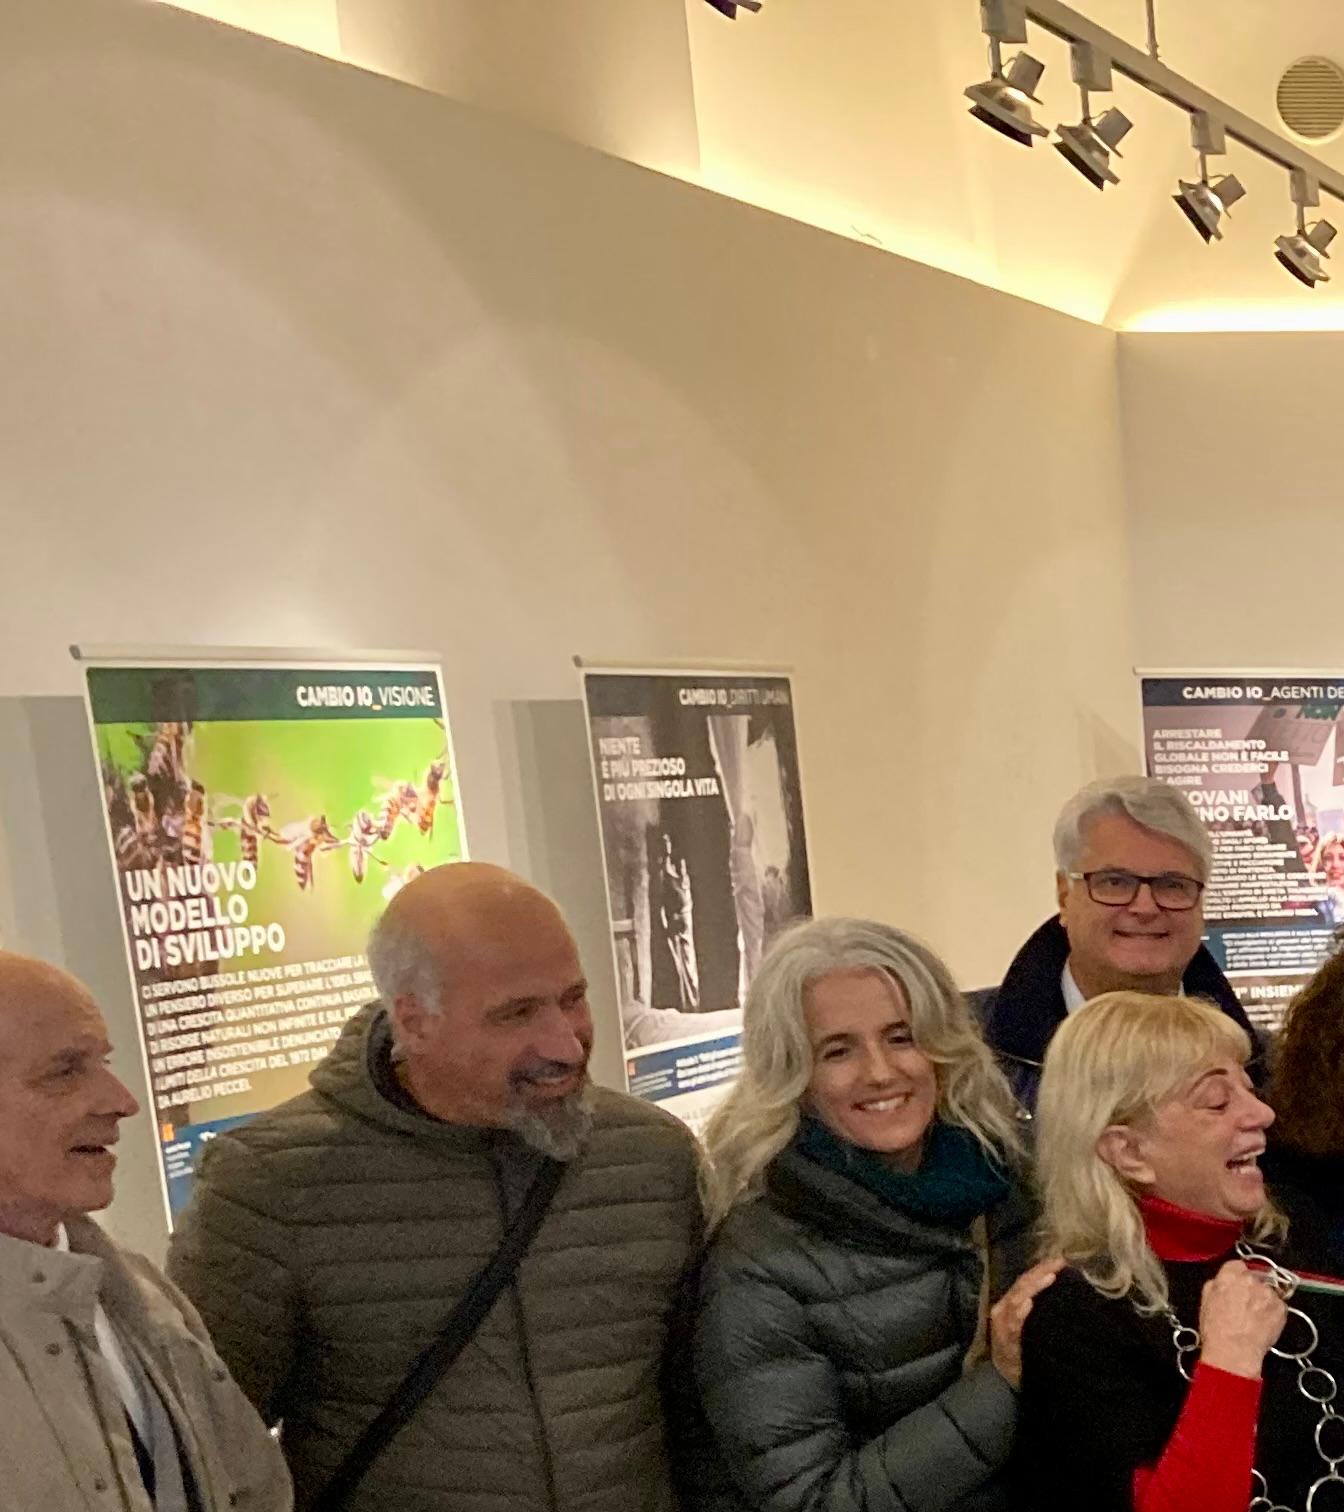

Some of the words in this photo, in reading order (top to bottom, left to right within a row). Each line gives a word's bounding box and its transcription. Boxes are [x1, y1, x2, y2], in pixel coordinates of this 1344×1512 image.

[296, 686, 354, 707] CAMBIO
[1182, 686, 1243, 699] CAMBIO
[1153, 728, 1222, 739] ARRESTARE
[1166, 739, 1266, 751] RISCALDAMENTO
[1154, 751, 1209, 762] GLOBALE
[1211, 751, 1239, 762] NON
[1250, 750, 1289, 762] FACILE
[1155, 763, 1210, 774] BISOGNA
[694, 777, 720, 796] VITA
[1233, 804, 1295, 821] FARLO
[125, 868, 163, 902] UN
[166, 860, 257, 898] NUOVO
[130, 894, 248, 937] MODELLO
[135, 937, 161, 971] DI
[164, 922, 286, 967] SVILUPPO
